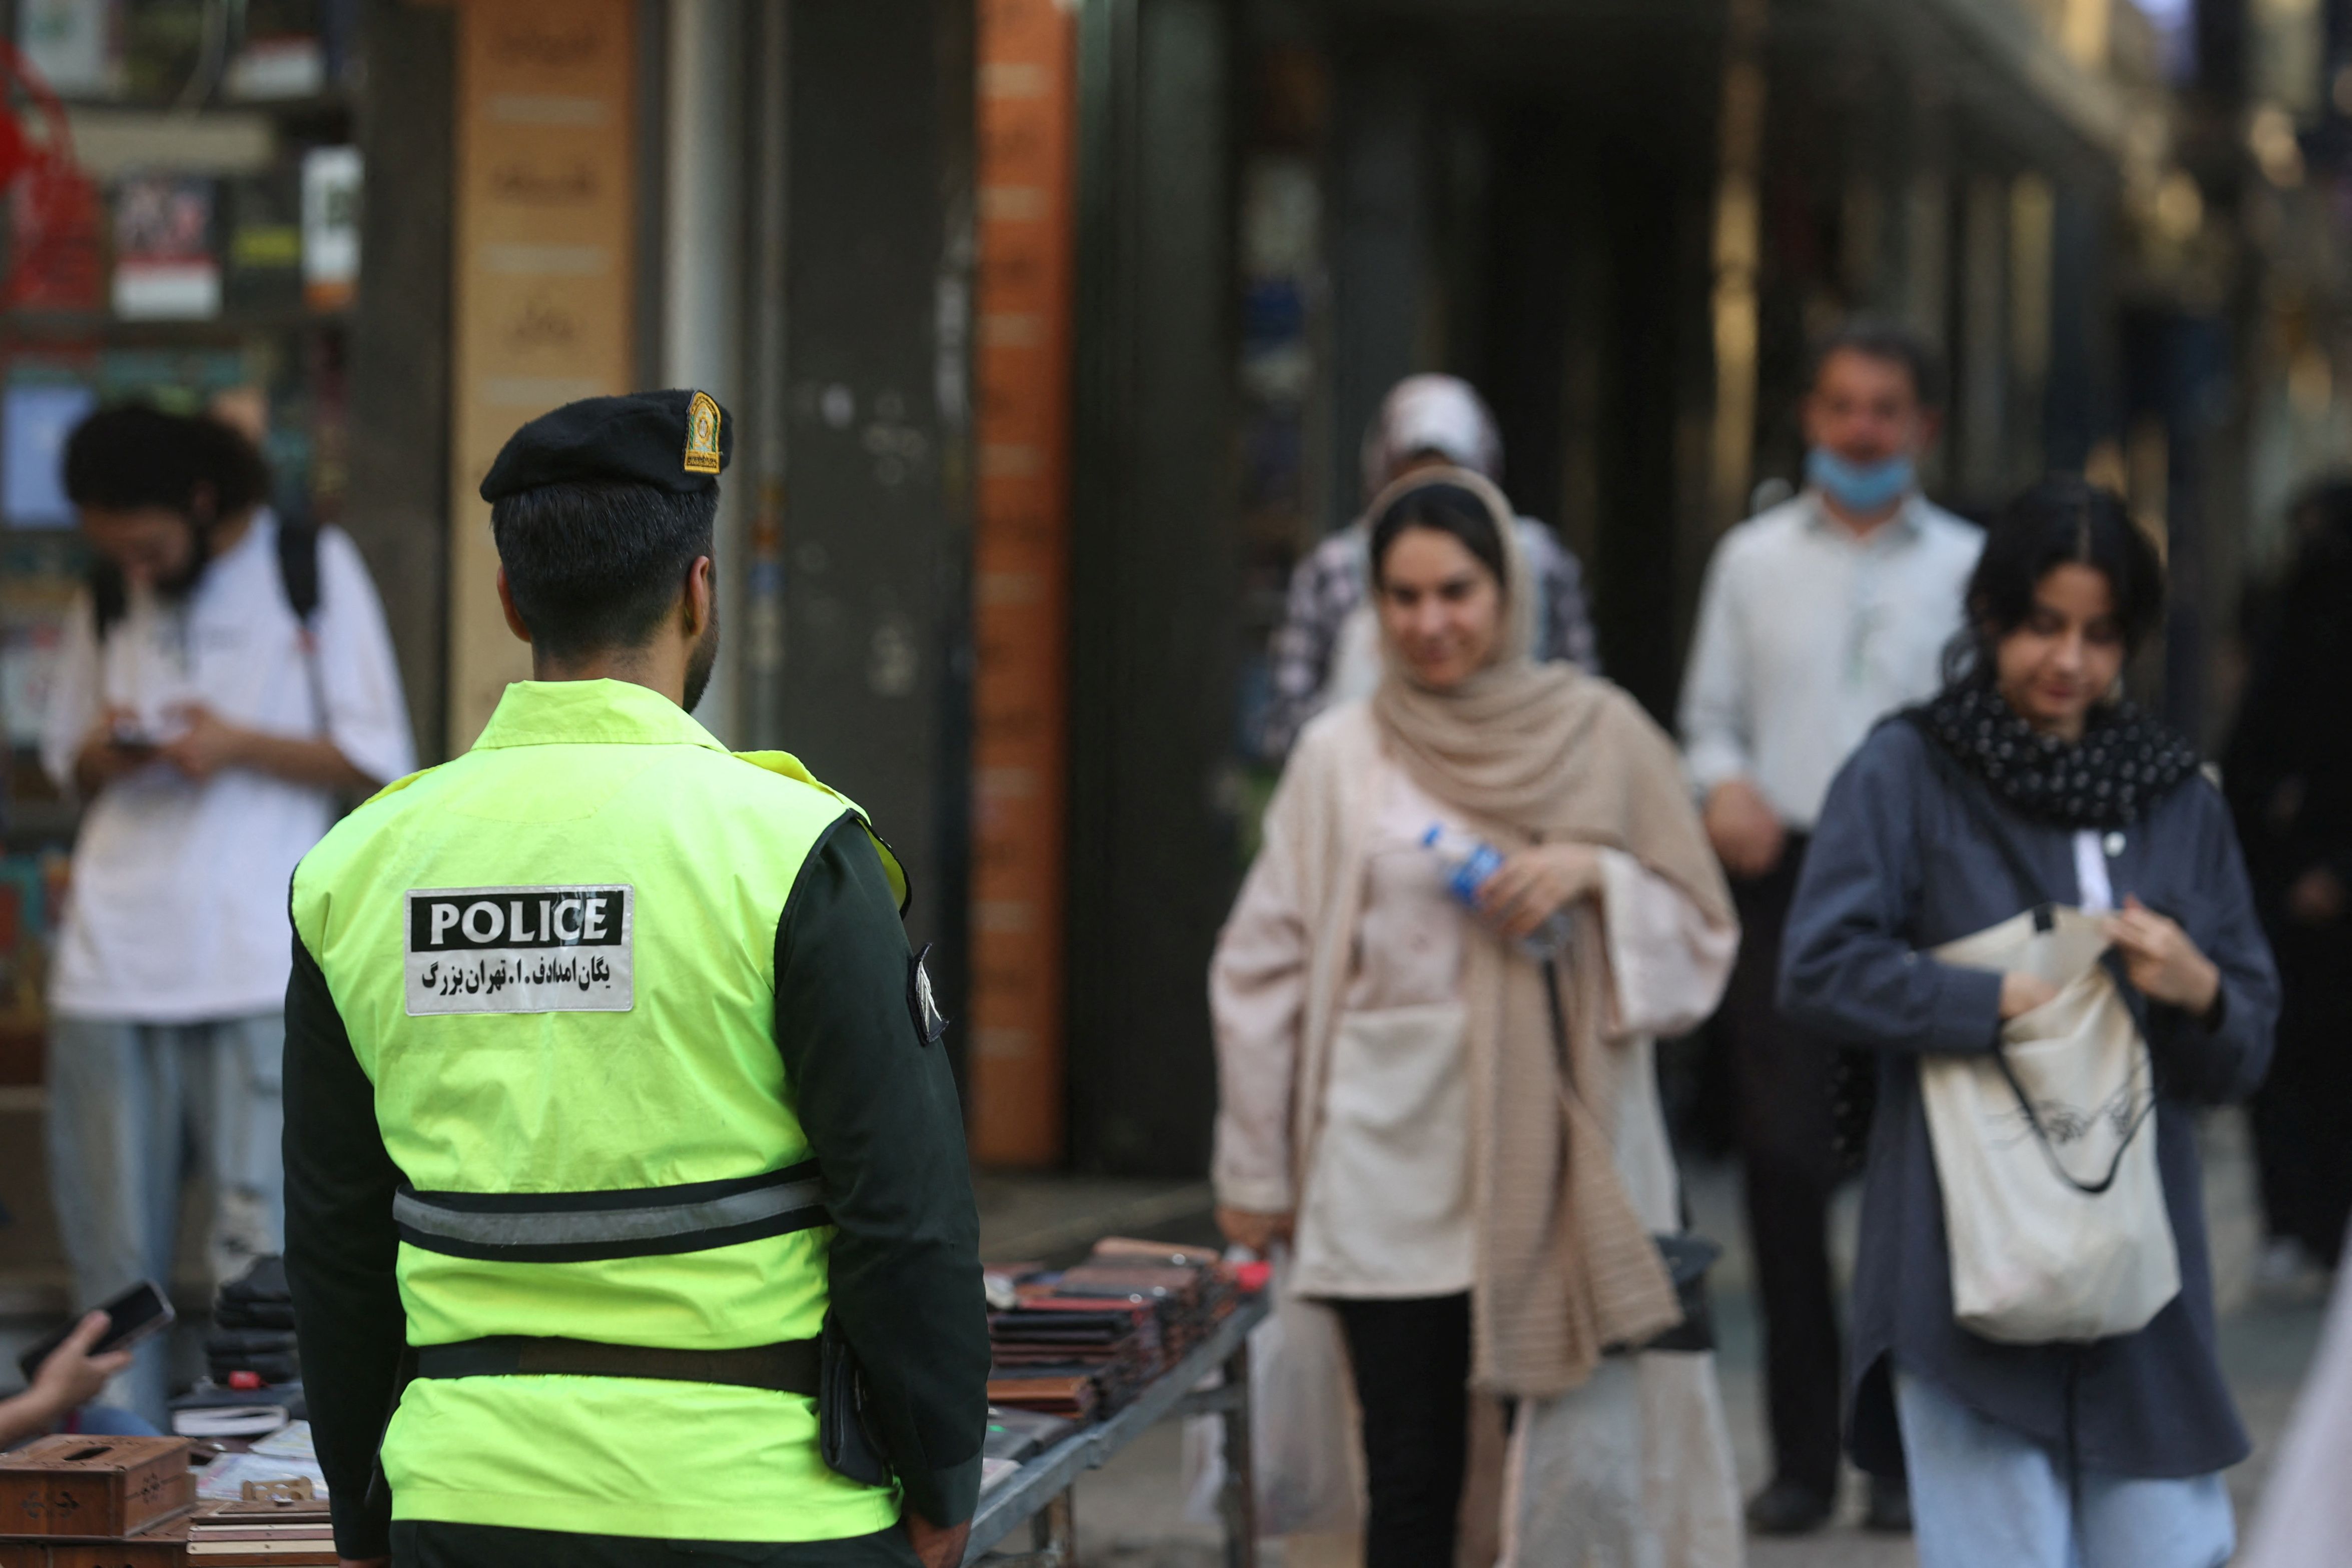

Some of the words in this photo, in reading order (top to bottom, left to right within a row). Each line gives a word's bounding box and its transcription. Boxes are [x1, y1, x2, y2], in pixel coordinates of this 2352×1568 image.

[430, 898, 608, 945] POLICE
[422, 961, 463, 996] بزرگ
[579, 956, 611, 992] یگان
